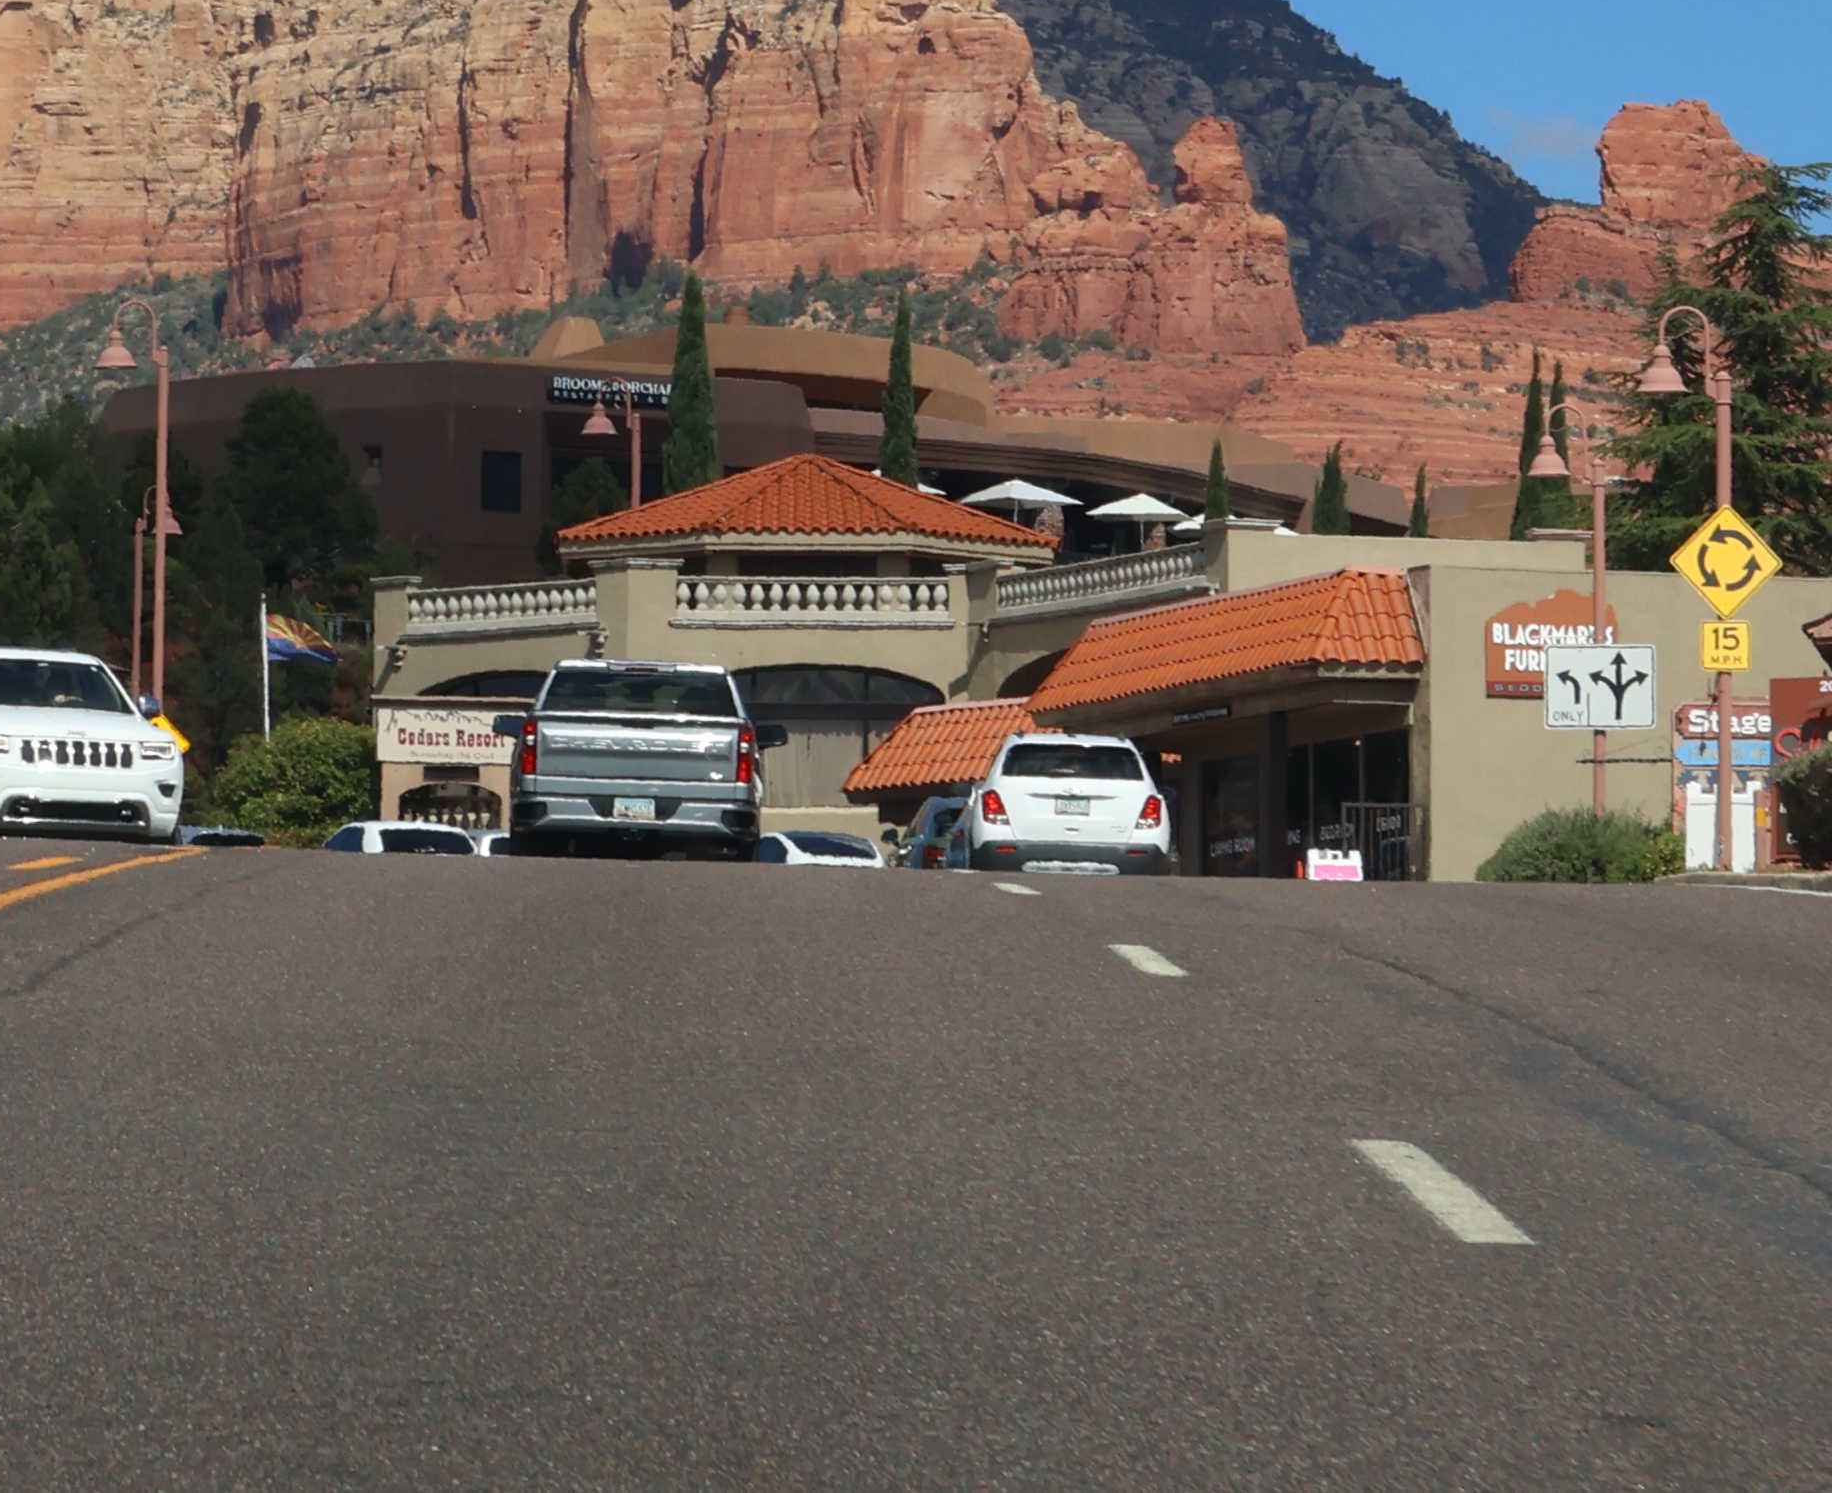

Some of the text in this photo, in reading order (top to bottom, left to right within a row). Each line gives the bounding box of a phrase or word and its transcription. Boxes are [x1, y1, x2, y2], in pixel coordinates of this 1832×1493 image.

[1712, 626, 1740, 651] 15
[1552, 710, 1584, 722] ONLY
[398, 727, 505, 748] Cedars Resort
